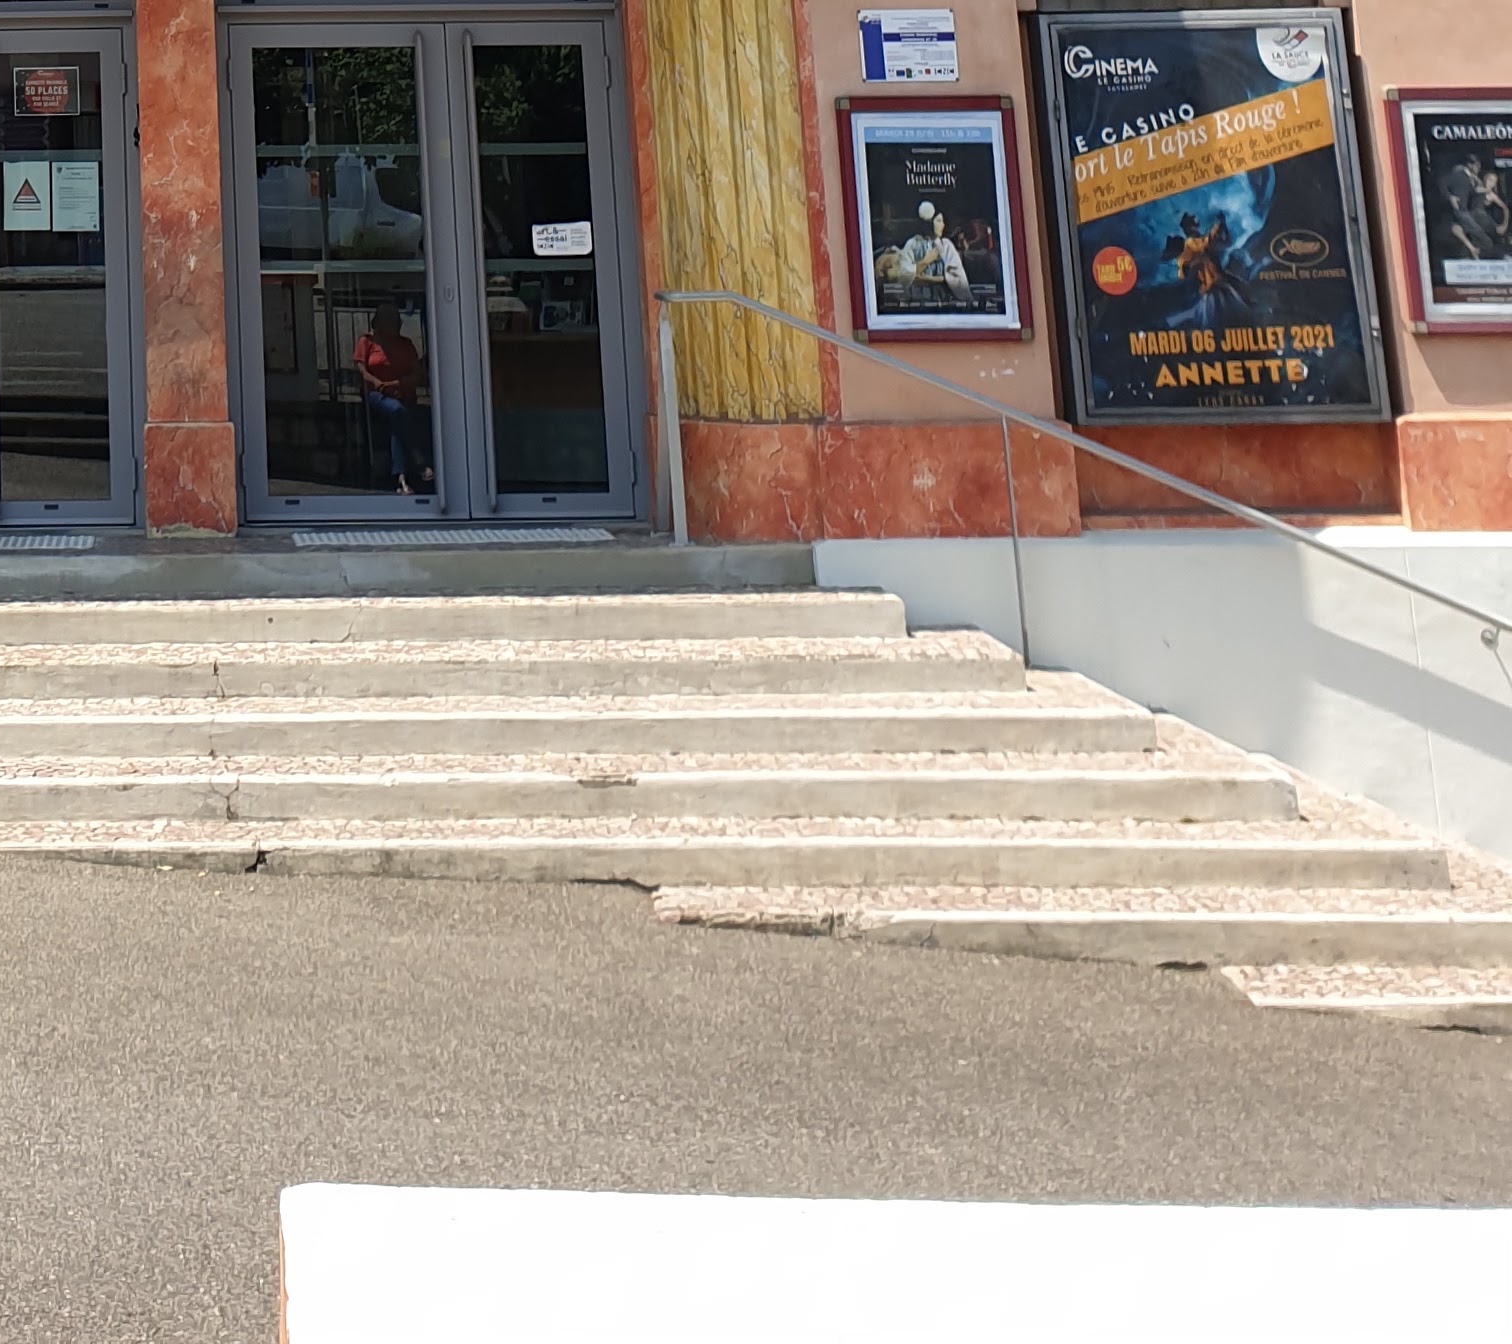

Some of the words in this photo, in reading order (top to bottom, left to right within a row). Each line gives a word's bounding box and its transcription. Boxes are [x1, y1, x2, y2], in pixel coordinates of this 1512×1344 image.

[1064, 45, 1159, 78] CINEMA
[25, 86, 36, 95] 50
[37, 85, 68, 95] PLACES
[1113, 74, 1152, 84] CASINO
[1101, 103, 1195, 144] CASINO
[1113, 143, 1135, 170] le
[1140, 125, 1208, 162] Tapis
[1213, 100, 1286, 141] Rouge
[905, 160, 956, 173] Madame
[906, 172, 957, 188] Butterfly
[1129, 330, 1186, 356] MARDI
[1192, 329, 1215, 351] 06
[1221, 326, 1285, 352] JUILLET
[1290, 323, 1334, 350] 2021
[1156, 358, 1306, 388] ANNETTE
